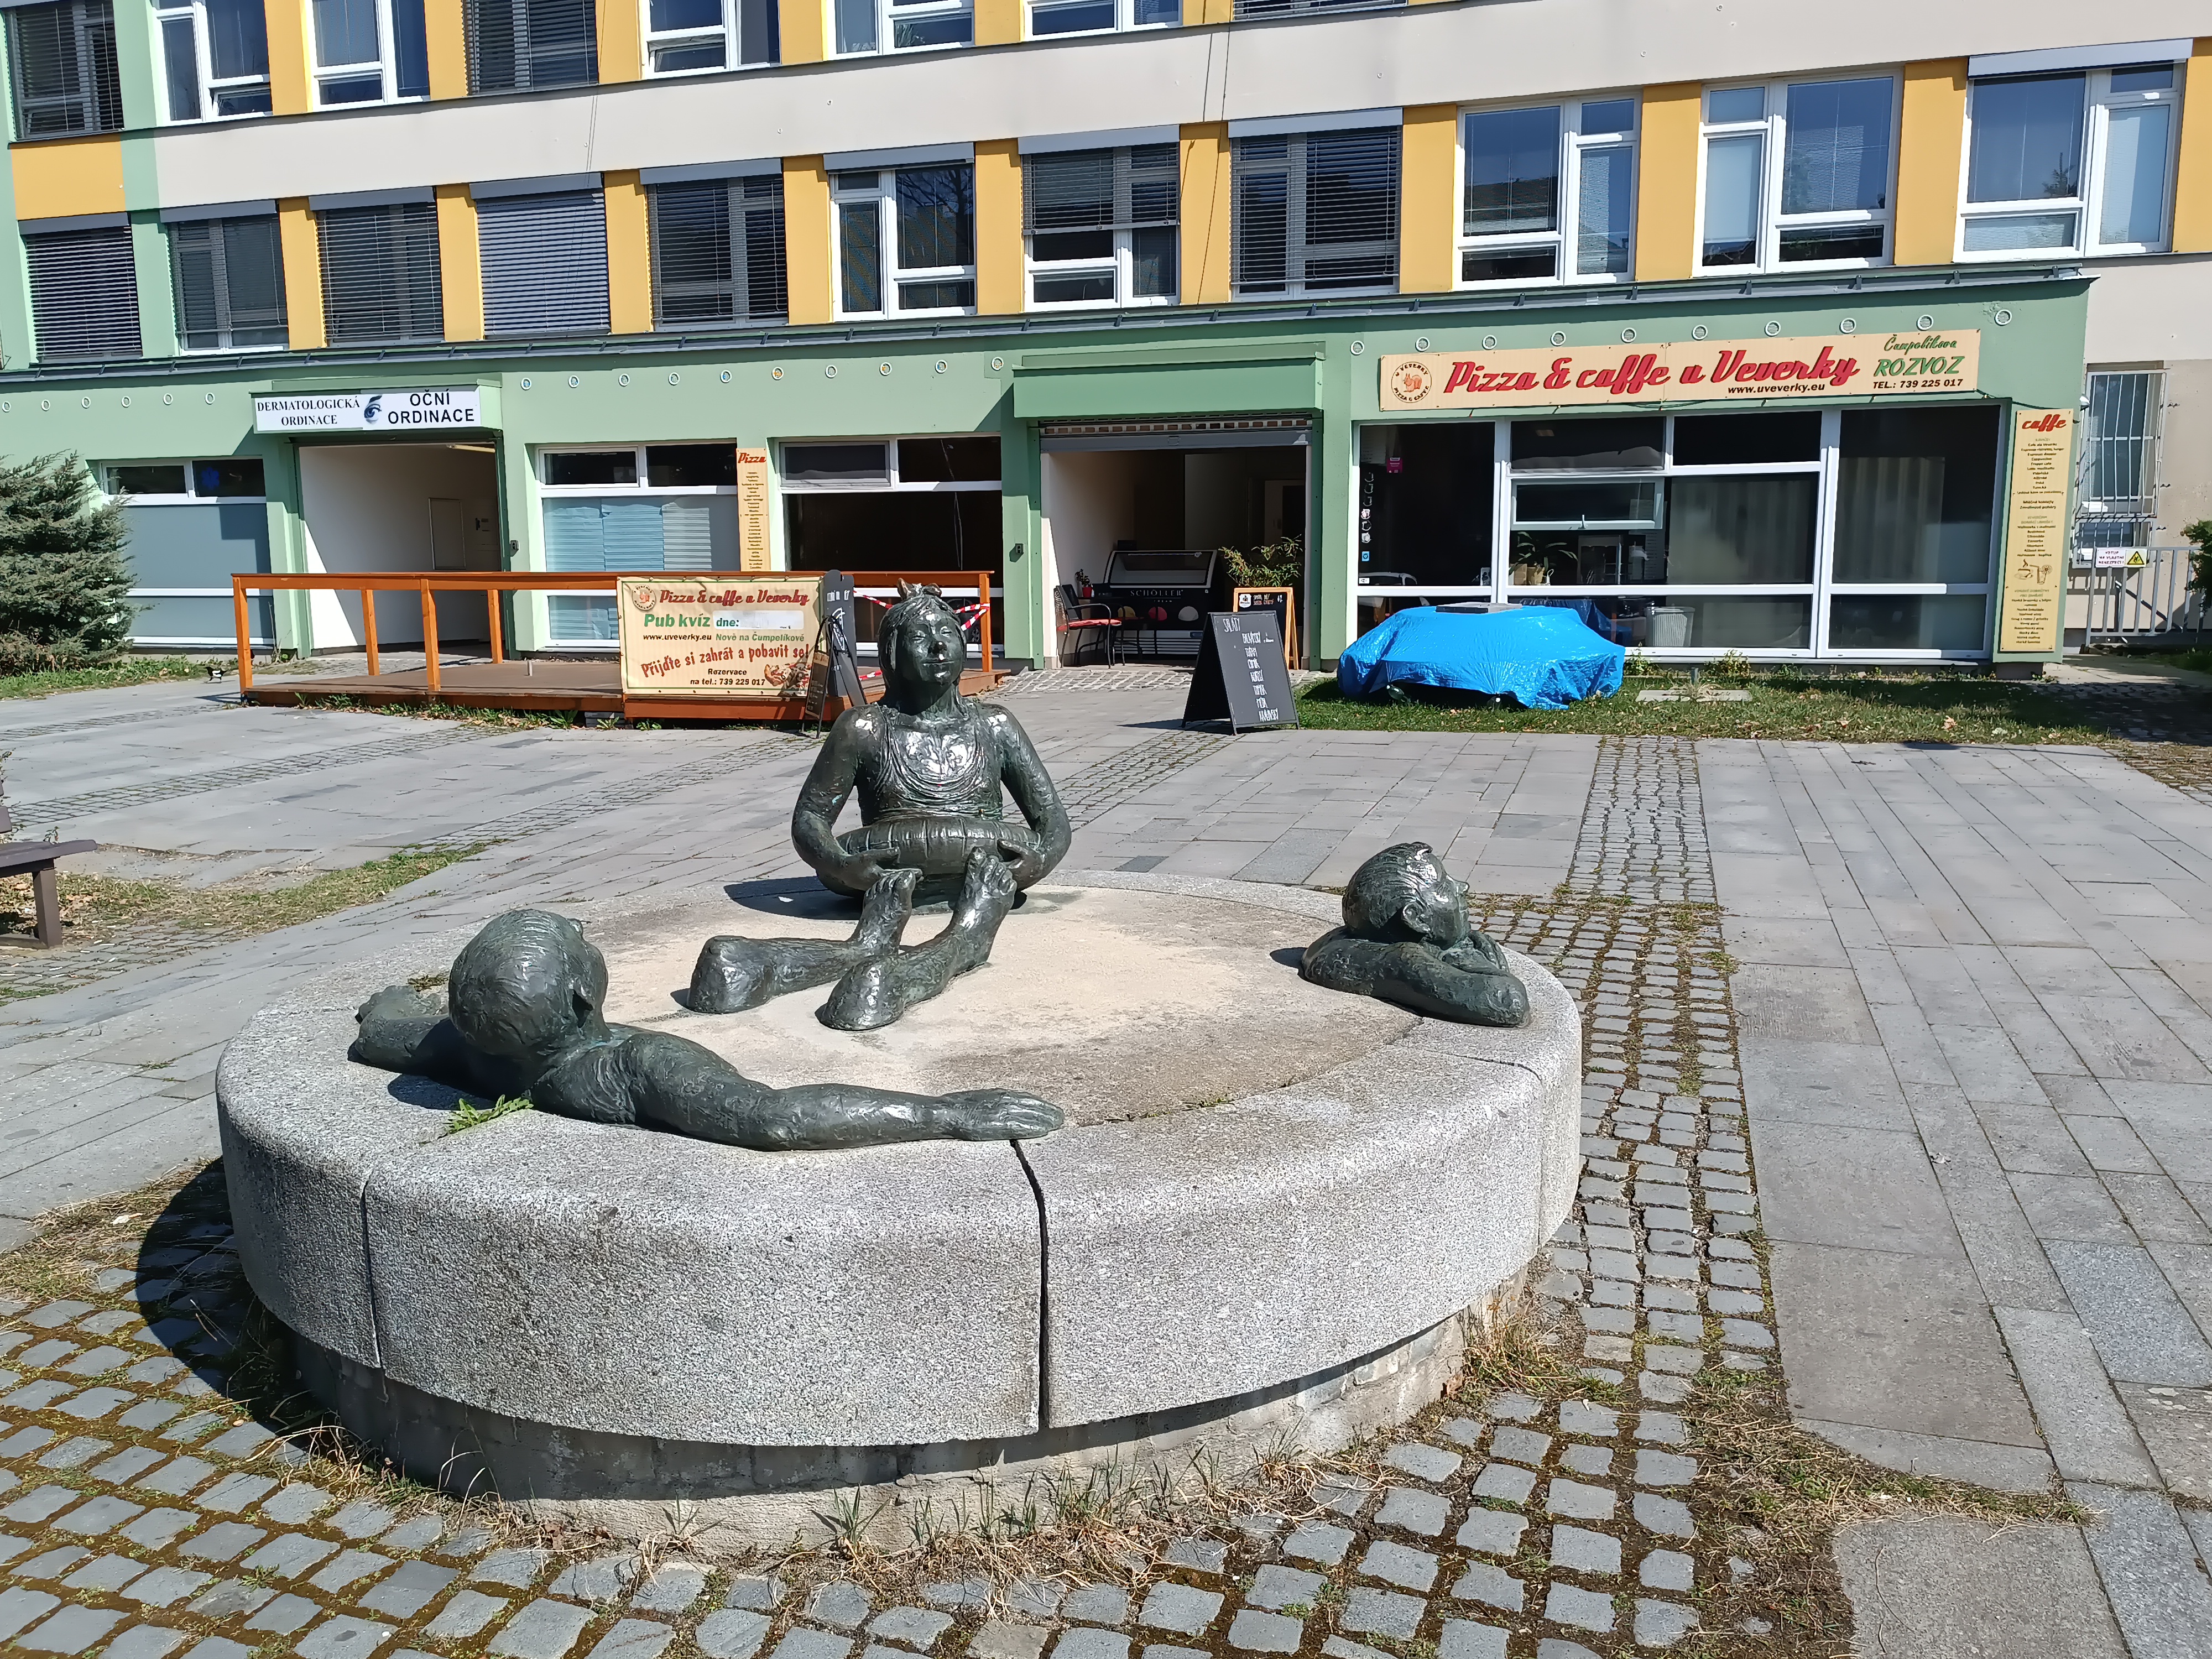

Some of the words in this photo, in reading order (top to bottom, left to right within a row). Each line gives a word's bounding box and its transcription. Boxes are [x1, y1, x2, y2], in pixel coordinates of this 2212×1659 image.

[1443, 361, 1540, 393] Pizza
[1543, 357, 1572, 389] &
[1576, 354, 1671, 394] caffe
[1710, 346, 1860, 386] Veverky
[1873, 356, 1965, 377] ROZVOZ
[410, 388, 450, 406] OČNÍ
[1728, 383, 1825, 394] www.uveverky.eu
[257, 395, 360, 411] DERMATOLOGICKÁ
[281, 415, 337, 426] ORDINACE
[388, 409, 474, 424] ORDINACE
[2022, 414, 2067, 432] caffe
[738, 452, 766, 463] Pizza
[660, 589, 696, 603] Pizza
[697, 589, 707, 603] &
[708, 590, 743, 607] caffe
[757, 589, 810, 606] Veverky
[644, 614, 675, 627] Pub
[679, 613, 711, 627] kvíz
[716, 618, 739, 627] dne:
[640, 655, 681, 678] Přijďte
[685, 651, 695, 665] si
[699, 647, 733, 663] zahrát
[738, 649, 744, 659] a
[749, 643, 789, 662] pobavit
[792, 643, 809, 659] se!
